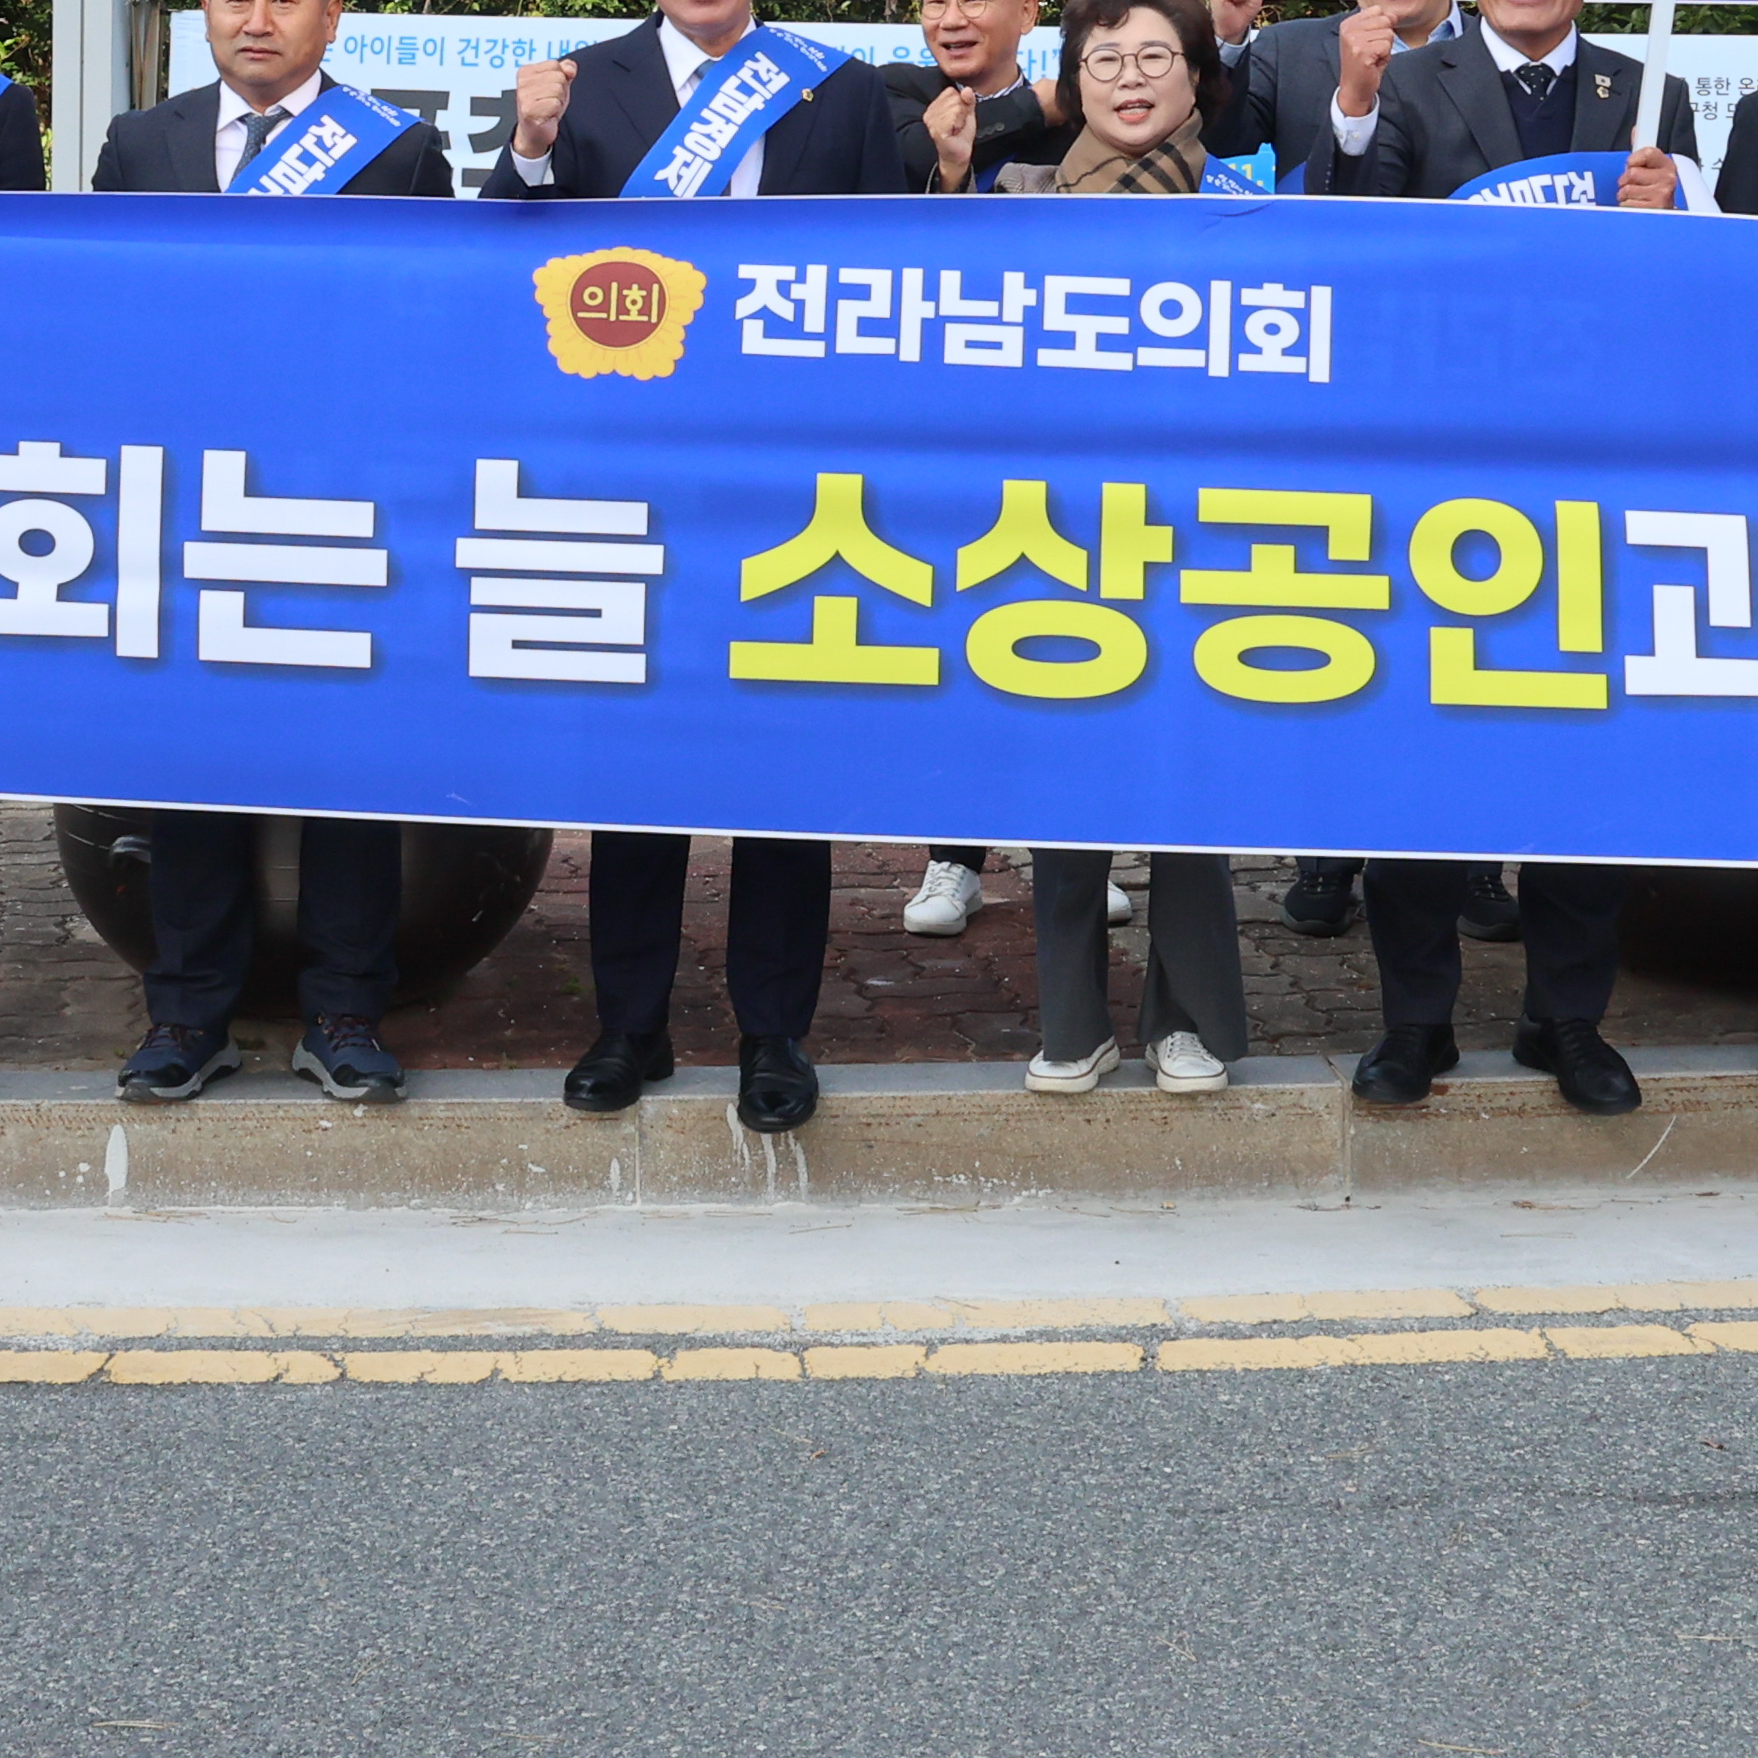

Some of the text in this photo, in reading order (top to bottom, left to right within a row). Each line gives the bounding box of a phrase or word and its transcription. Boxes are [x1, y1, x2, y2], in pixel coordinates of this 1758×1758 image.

[344, 35, 446, 67] 아이들이
[456, 38, 538, 69] 건강한
[1695, 76, 1731, 97] 통한
[576, 283, 661, 325] 의회
[735, 262, 1333, 384] 전라남도의회
[453, 456, 667, 687] 늘
